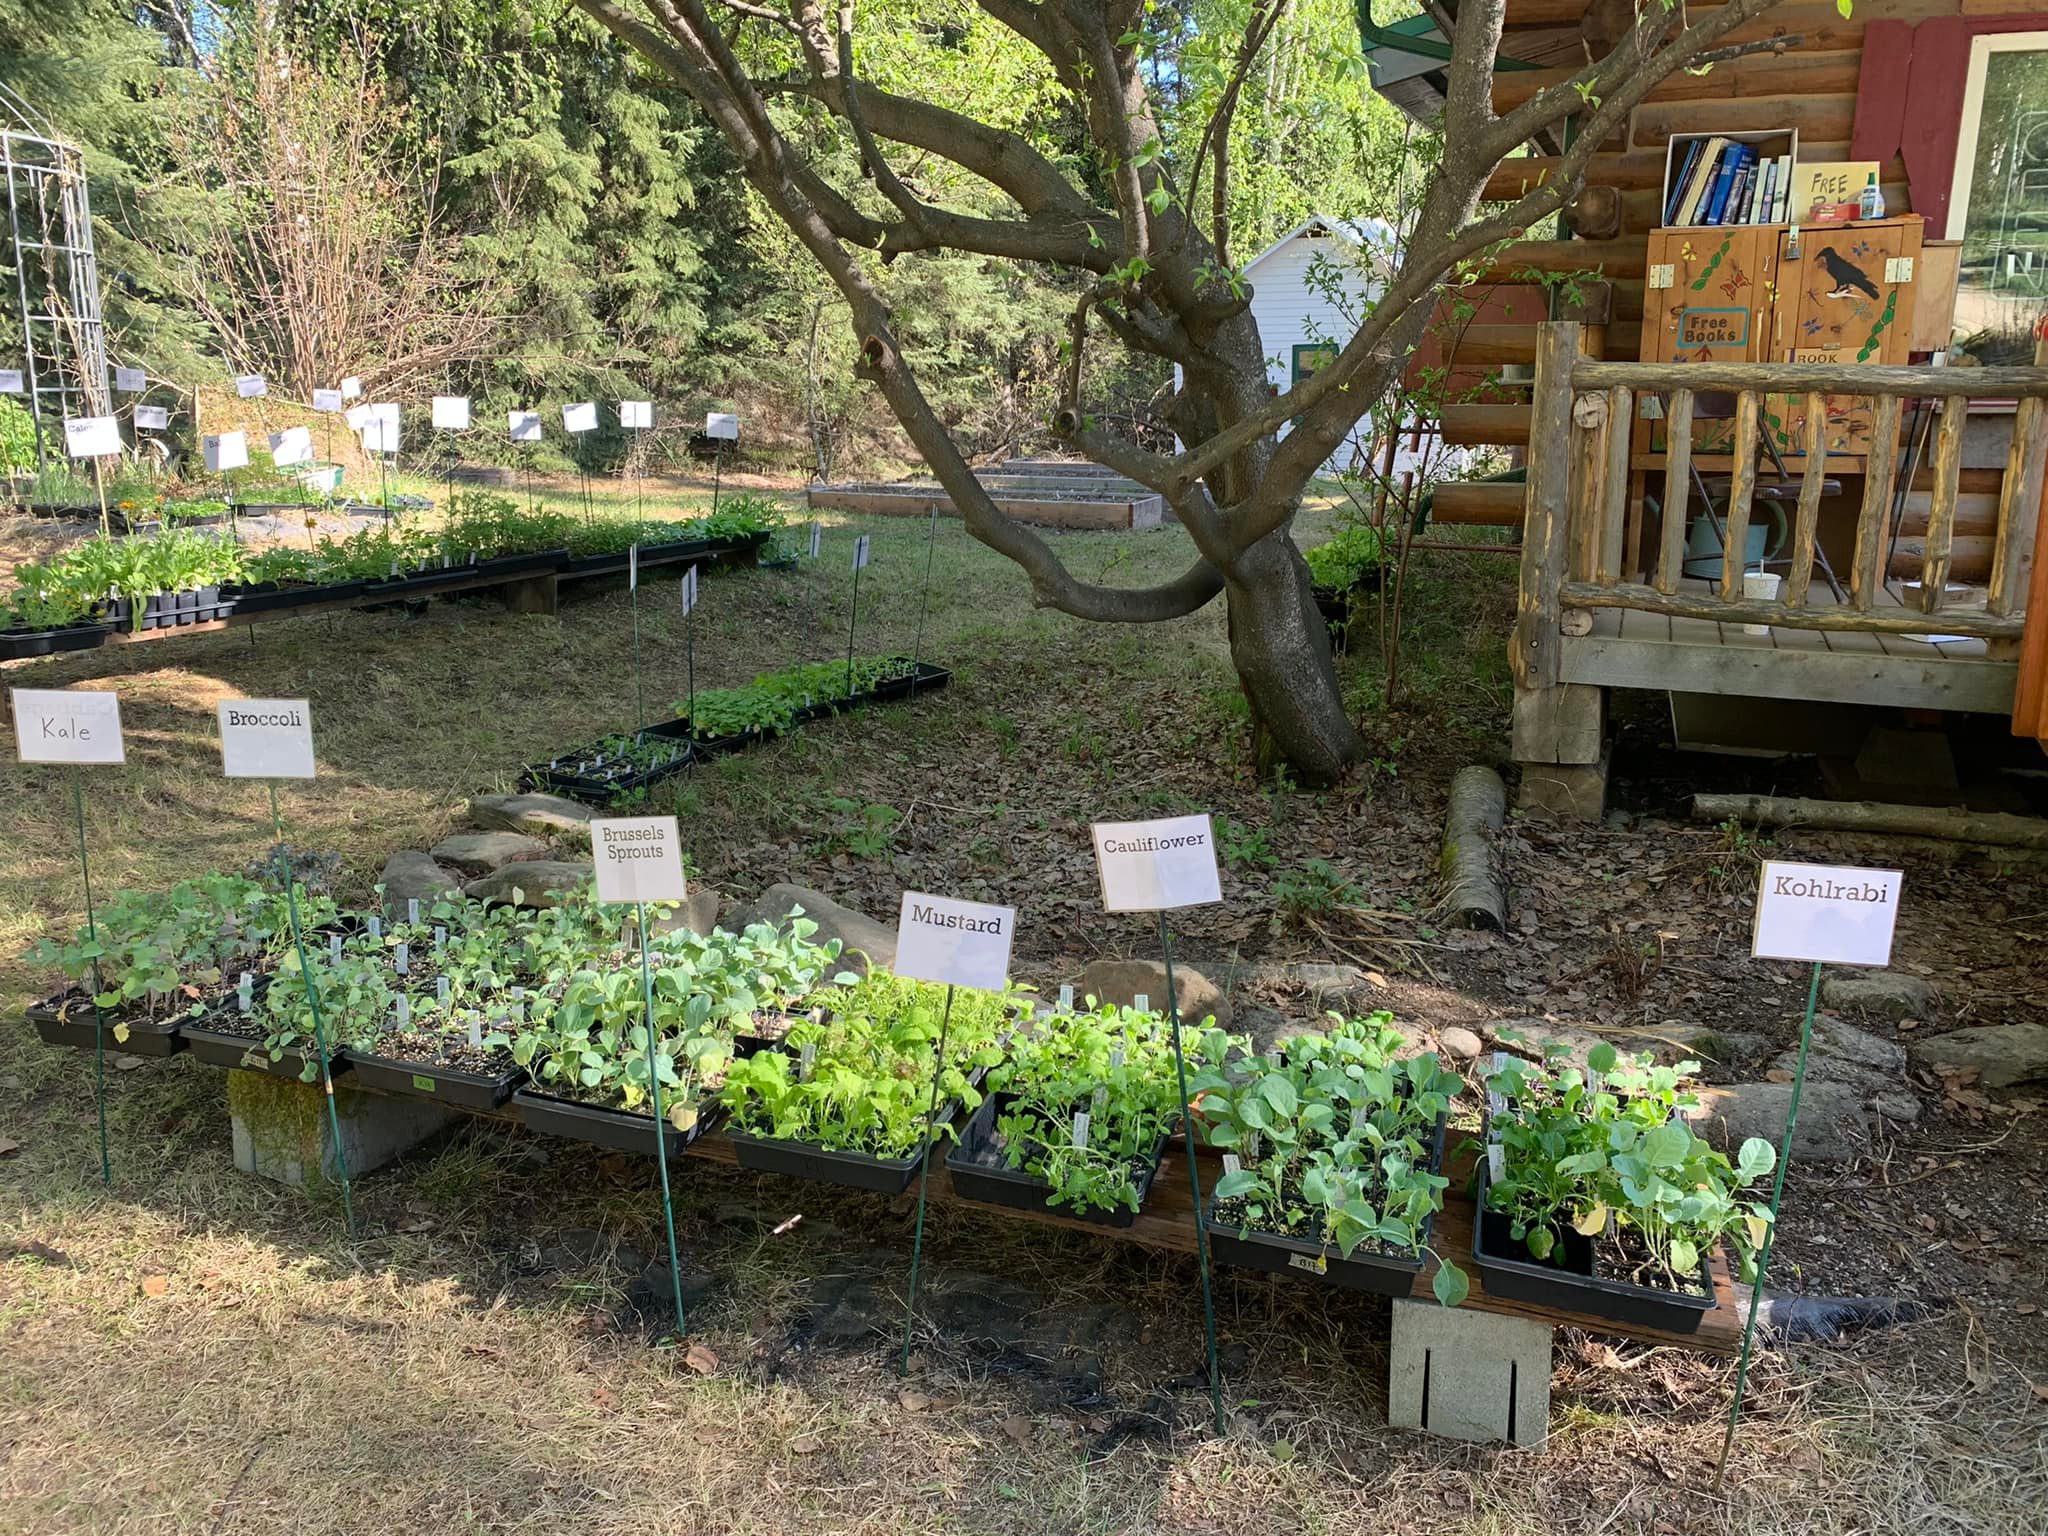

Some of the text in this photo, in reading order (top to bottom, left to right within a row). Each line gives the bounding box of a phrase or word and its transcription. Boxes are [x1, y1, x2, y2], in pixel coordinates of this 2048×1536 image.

[1811, 172, 1847, 194] FREE
[1691, 316, 1727, 328] Free
[1684, 330, 1736, 342] Books
[228, 710, 301, 726] Broccoli
[41, 717, 91, 740] Kale
[602, 825, 664, 842] Brussels
[1104, 834, 1204, 853] Cauliflower
[608, 845, 664, 863] Sprouts
[1774, 876, 1887, 902] Kohlrabi
[912, 904, 1001, 935] Mustard
